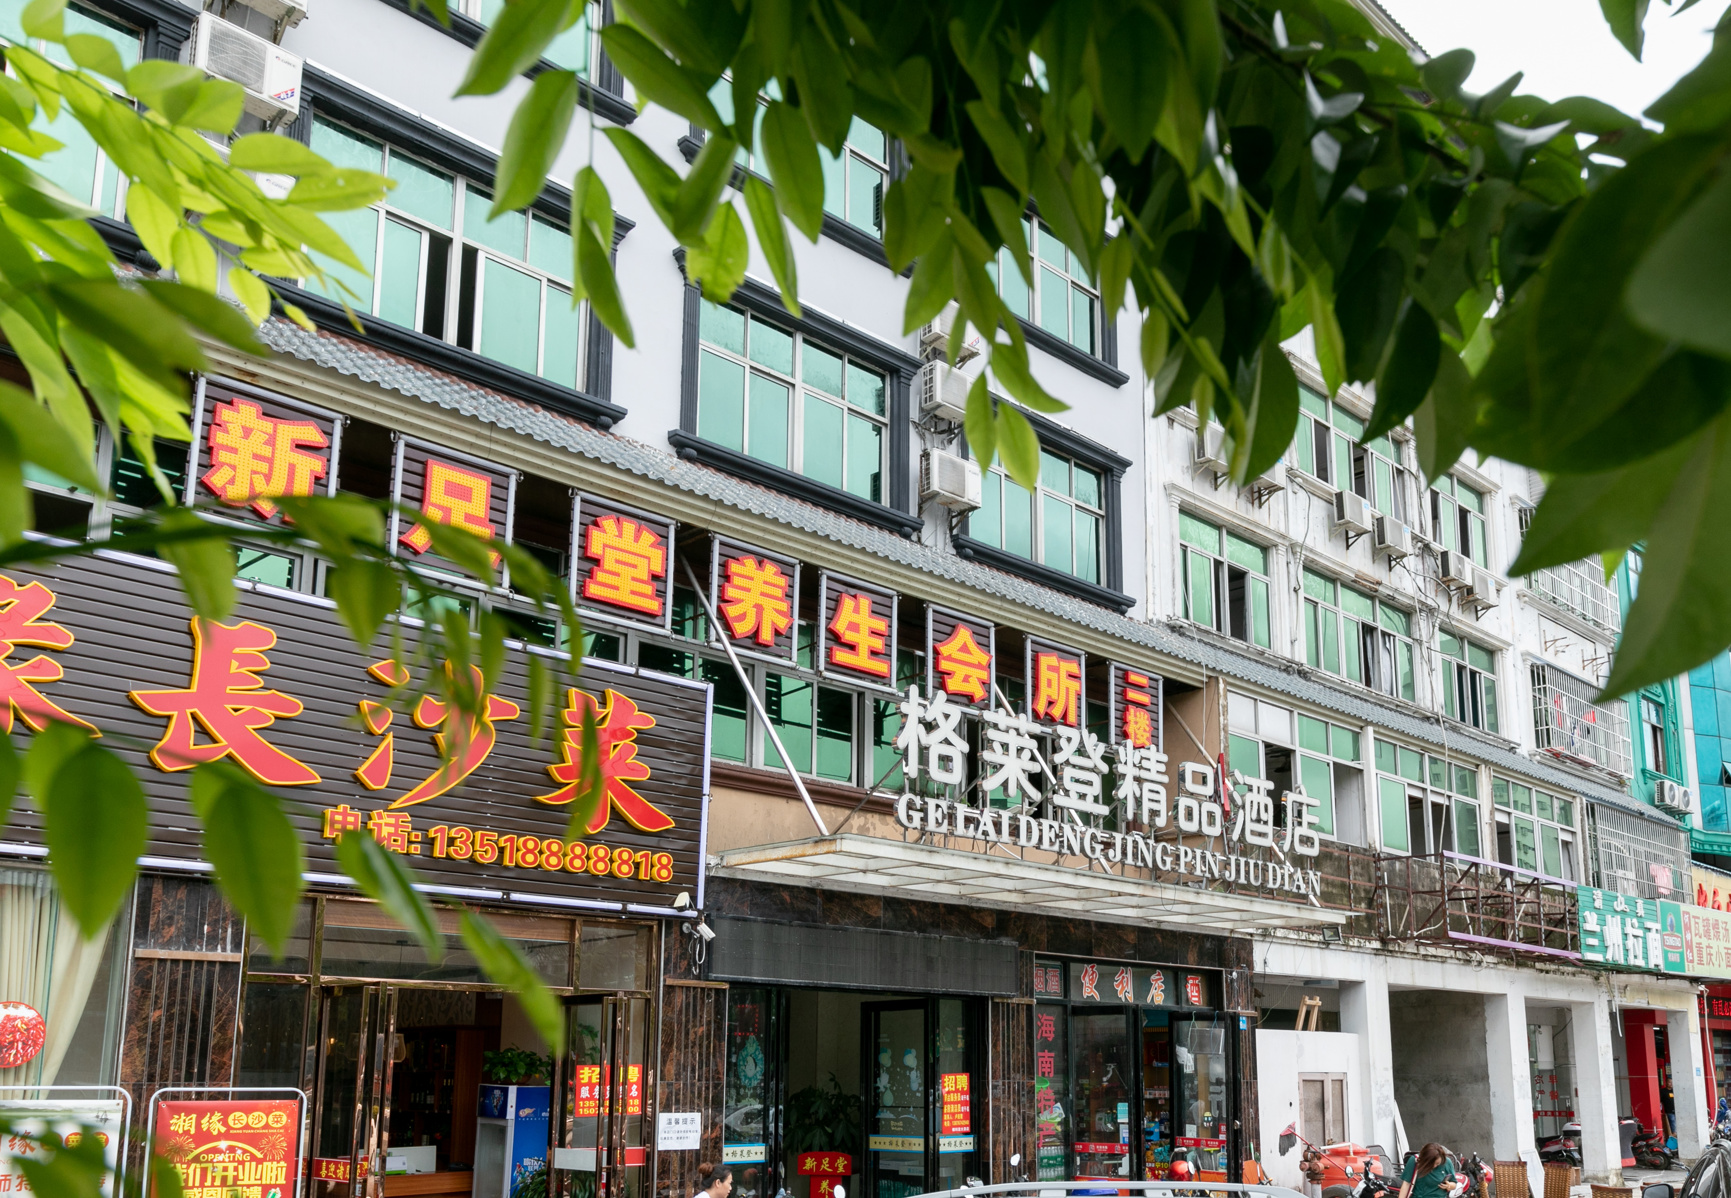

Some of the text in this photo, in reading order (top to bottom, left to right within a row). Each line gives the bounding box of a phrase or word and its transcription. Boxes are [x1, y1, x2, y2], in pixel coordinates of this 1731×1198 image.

[1123, 670, 1153, 748] 二楼
[896, 684, 1322, 858] 格莱登精品酒店
[1108, 831, 1174, 872] JING
[1178, 845, 1221, 879] PIN
[1224, 854, 1264, 887] JIU
[1266, 862, 1322, 897] DIAN
[1582, 910, 1662, 969] 兰州拉面
[1081, 963, 1166, 1006] 便利店
[944, 1074, 968, 1092] 招聘
[1036, 1013, 1056, 1149] 海南特产
[169, 1111, 286, 1135] 湘缘 长沙菜
[802, 1156, 848, 1174] 新足堂
